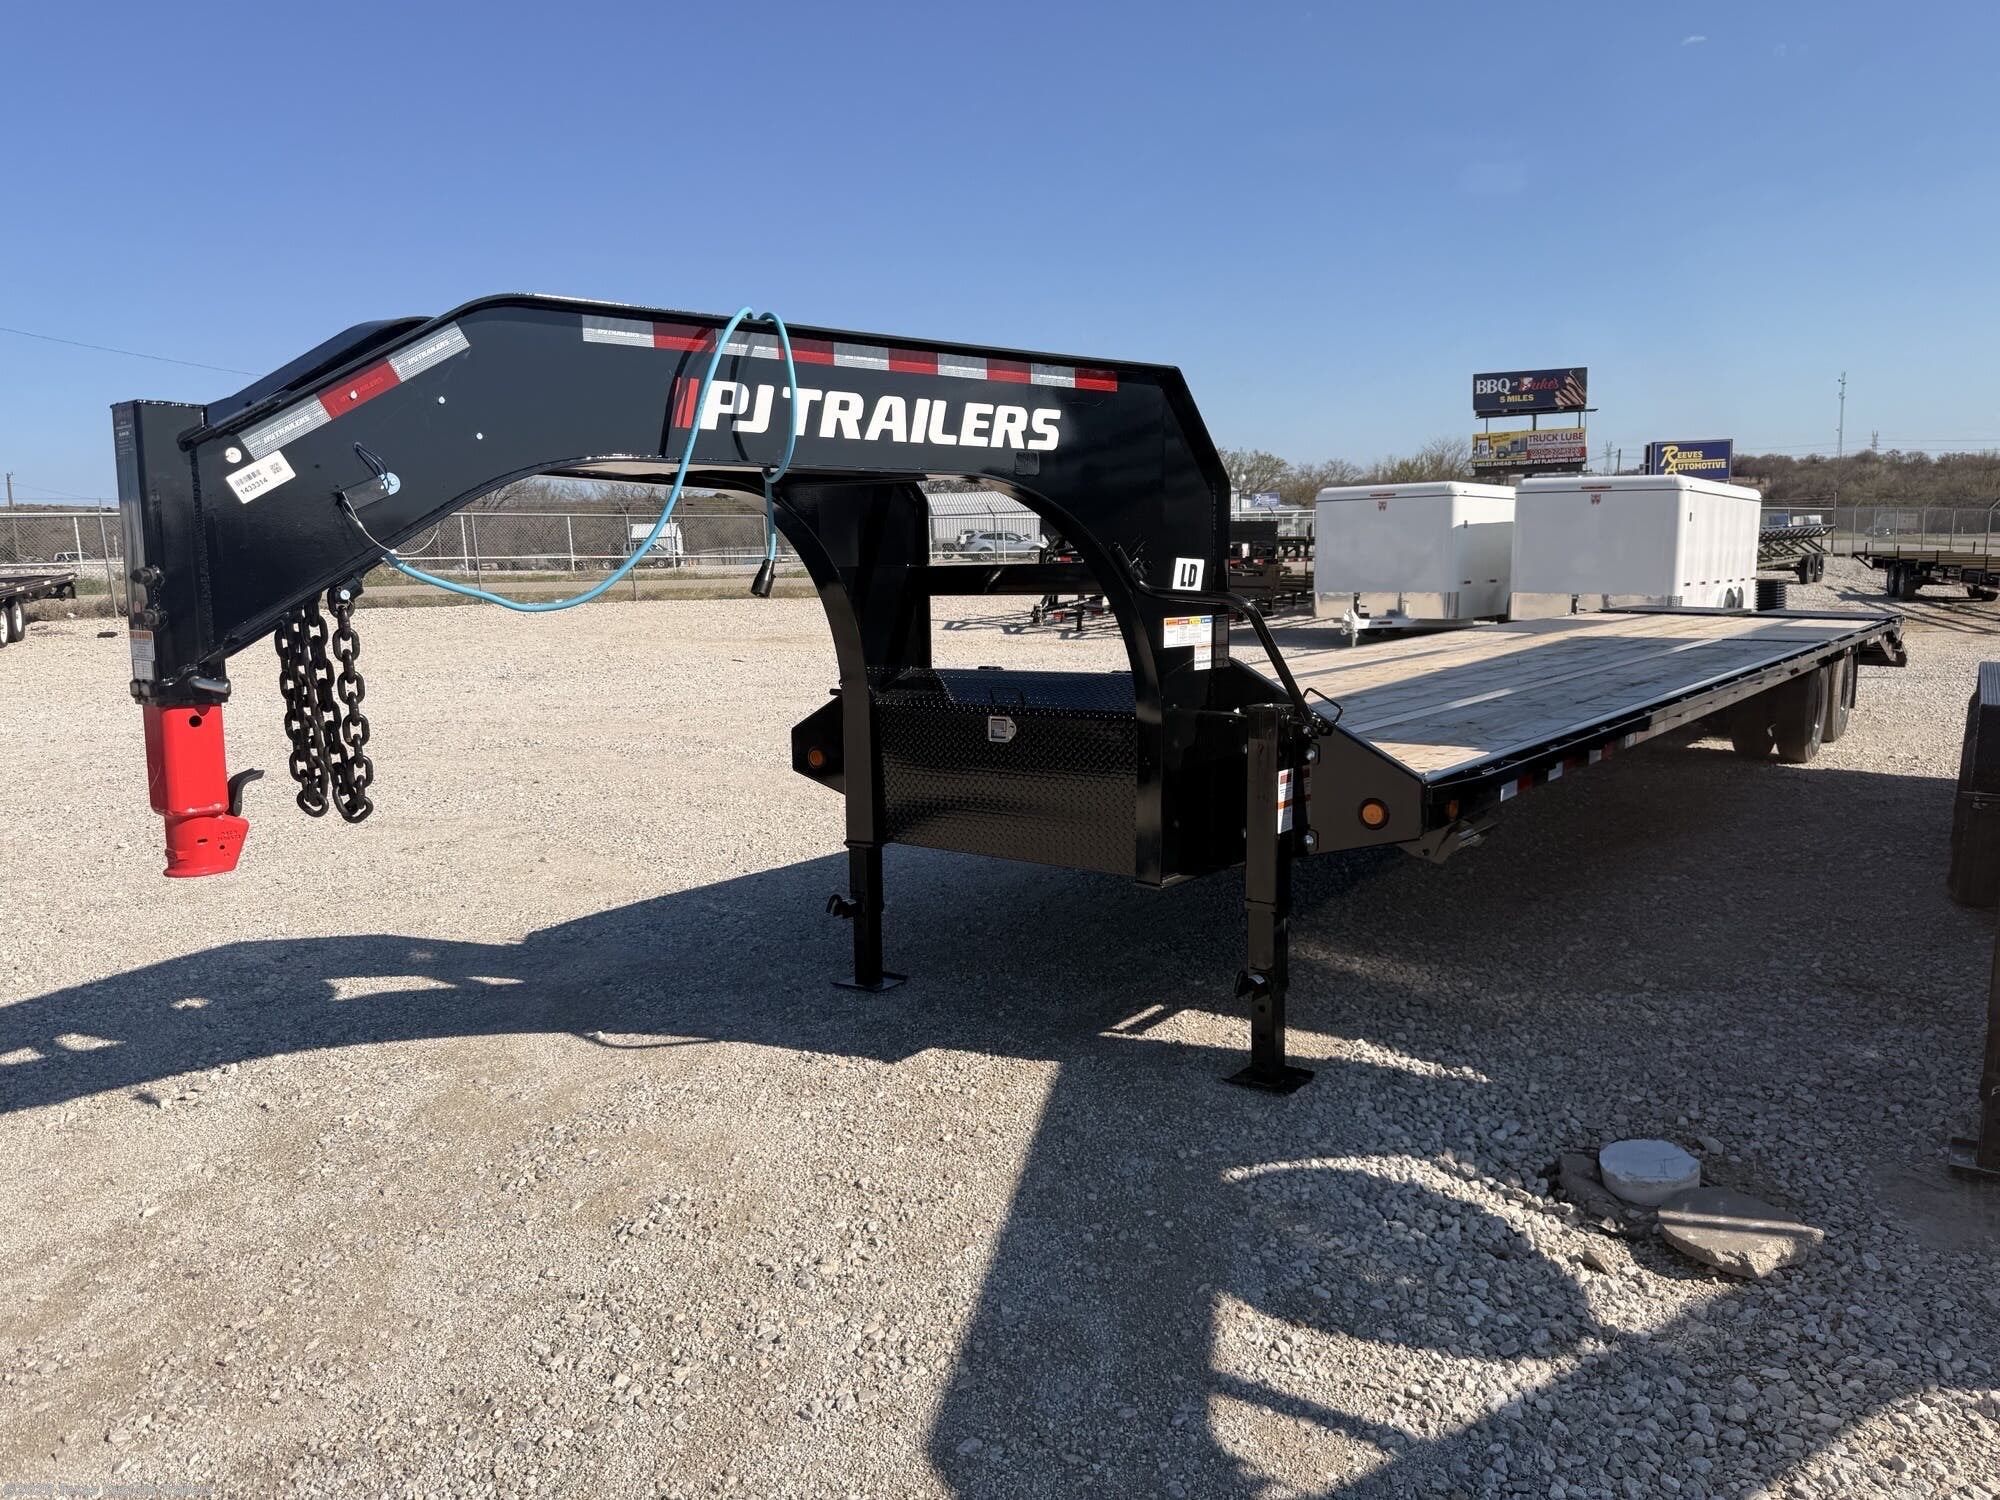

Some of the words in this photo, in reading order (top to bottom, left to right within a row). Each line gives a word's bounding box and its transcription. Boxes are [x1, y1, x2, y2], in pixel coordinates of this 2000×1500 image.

[1476, 378, 1511, 394] BBQ
[1507, 394, 1534, 402] MILES
[699, 379, 775, 433] PJ
[782, 386, 1062, 451] TRAILERS
[1528, 434, 1558, 442] TRUCK
[1560, 432, 1584, 441] LUBE
[1660, 446, 1703, 467] REEVES
[1664, 460, 1727, 476] AUTOMOTIVE
[240, 477, 269, 495] 1433314
[1180, 563, 1198, 588] LD
